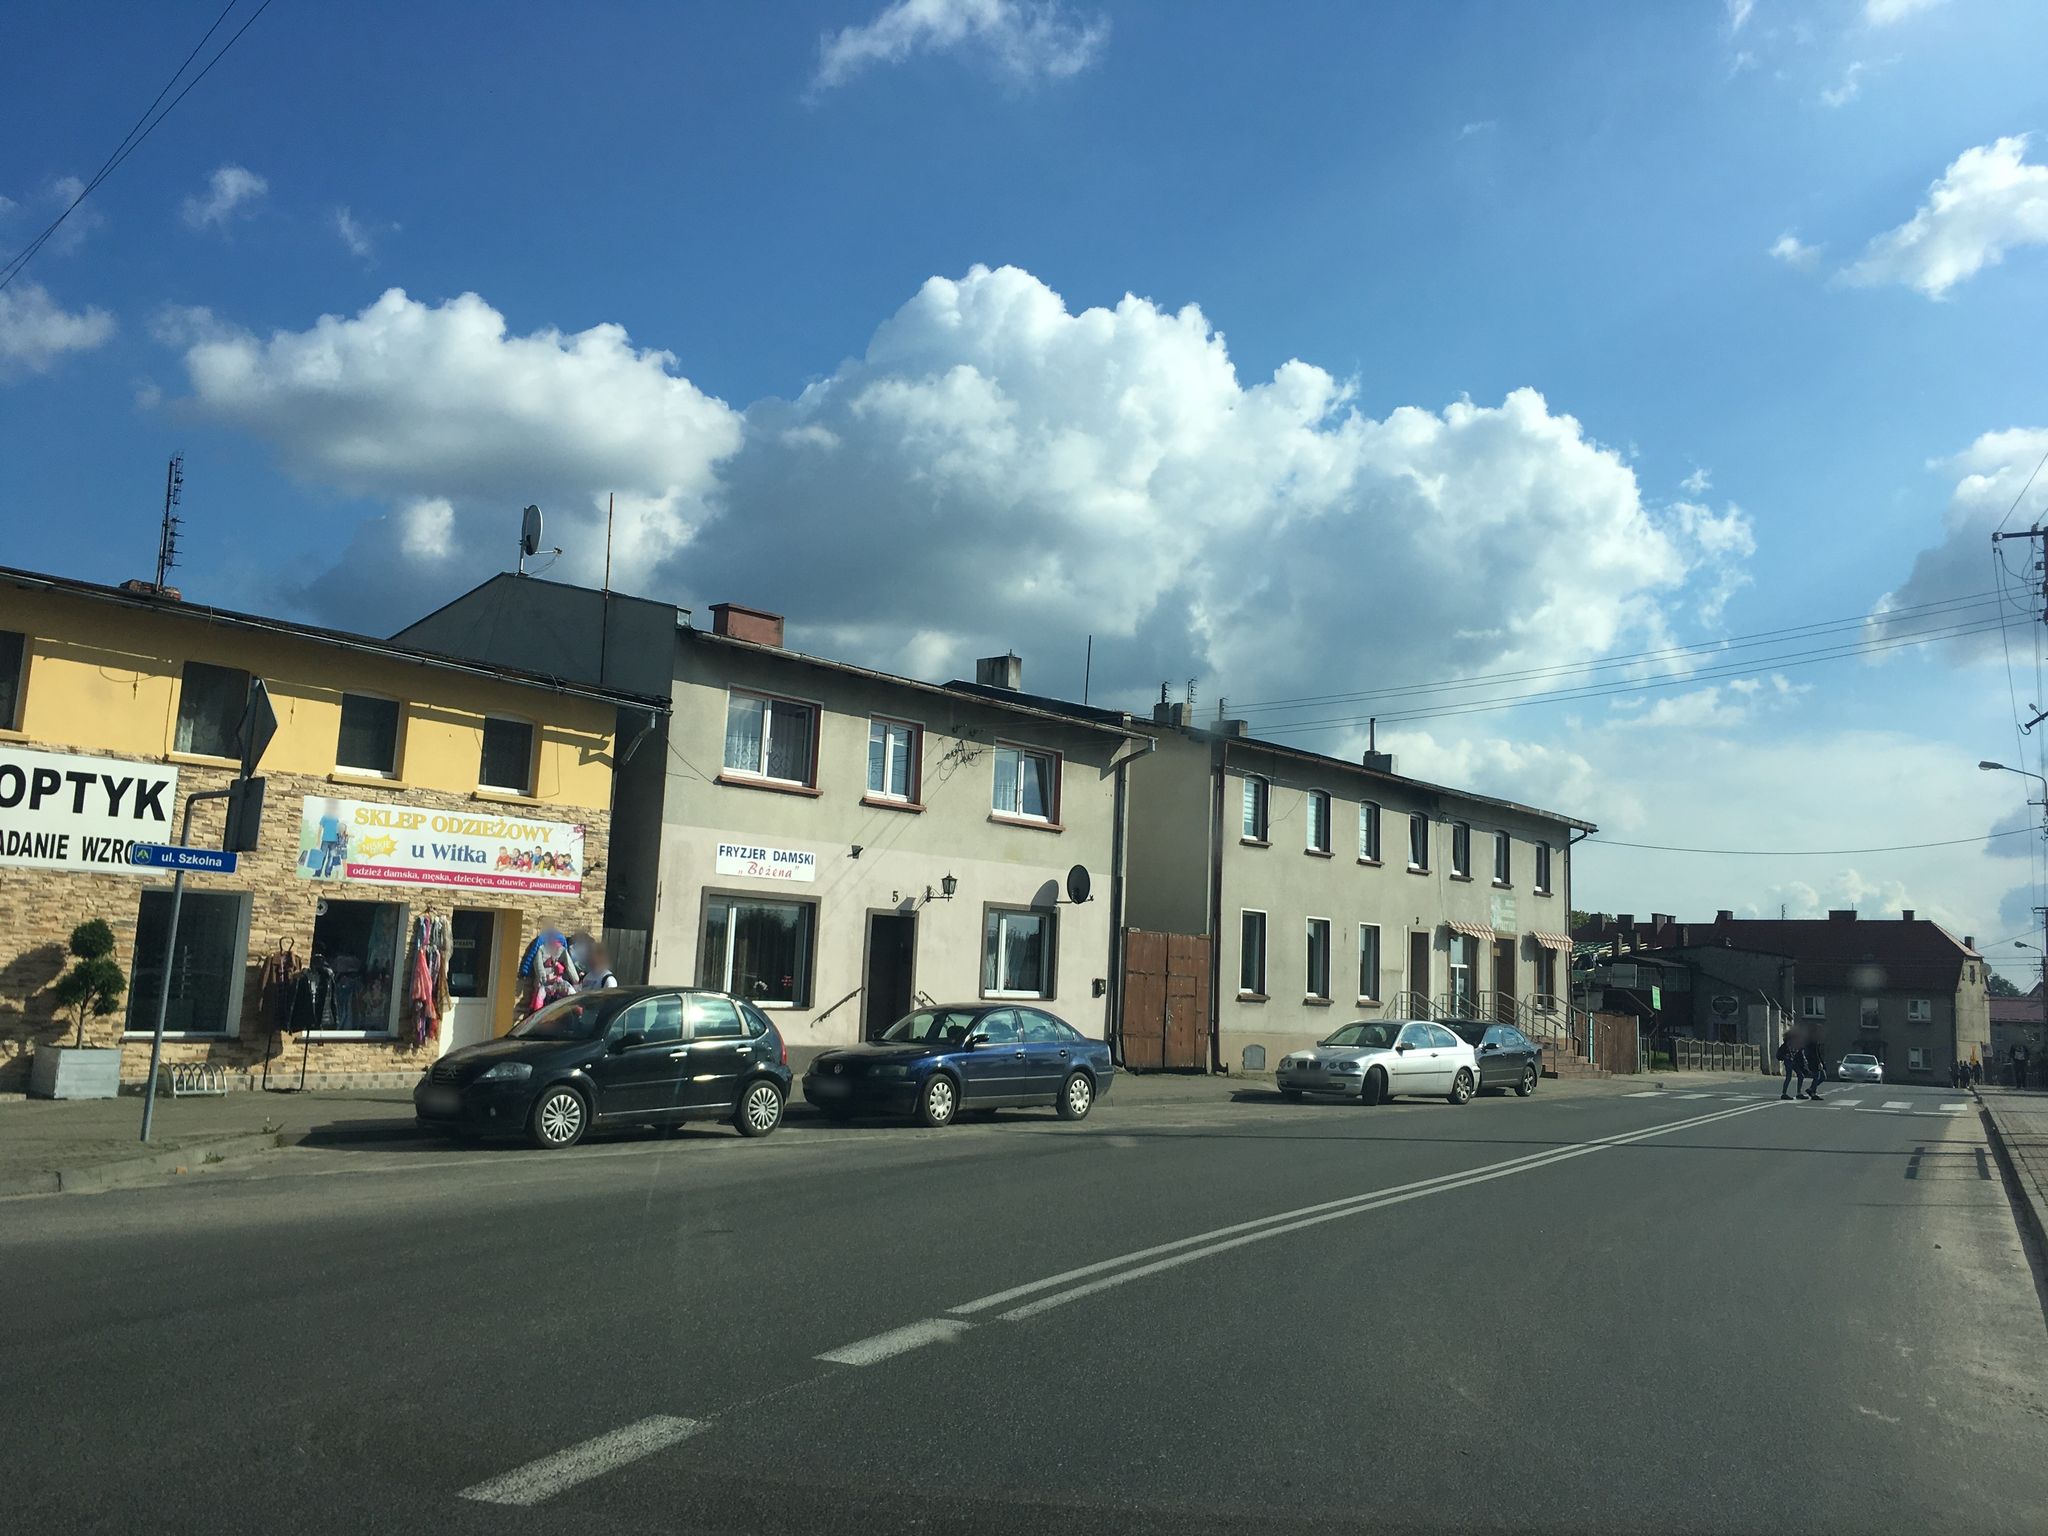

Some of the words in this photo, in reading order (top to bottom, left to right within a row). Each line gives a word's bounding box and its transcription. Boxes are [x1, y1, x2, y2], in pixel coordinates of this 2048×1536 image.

[0, 764, 170, 822] OPTYK
[354, 807, 428, 830] SKLEP
[431, 814, 554, 843] ODZIEŻOWY
[0, 829, 70, 860] DANIE
[411, 844, 425, 859] u
[431, 843, 488, 864] Witka
[719, 845, 767, 861] FRYZJER
[773, 850, 815, 866] DAMSKI
[161, 852, 175, 863] ul.
[178, 853, 222, 867] Szkolna
[352, 867, 382, 877] odzież
[384, 869, 420, 879] damska,
[529, 880, 576, 891] pasmanteria
[892, 890, 899, 903] 5
